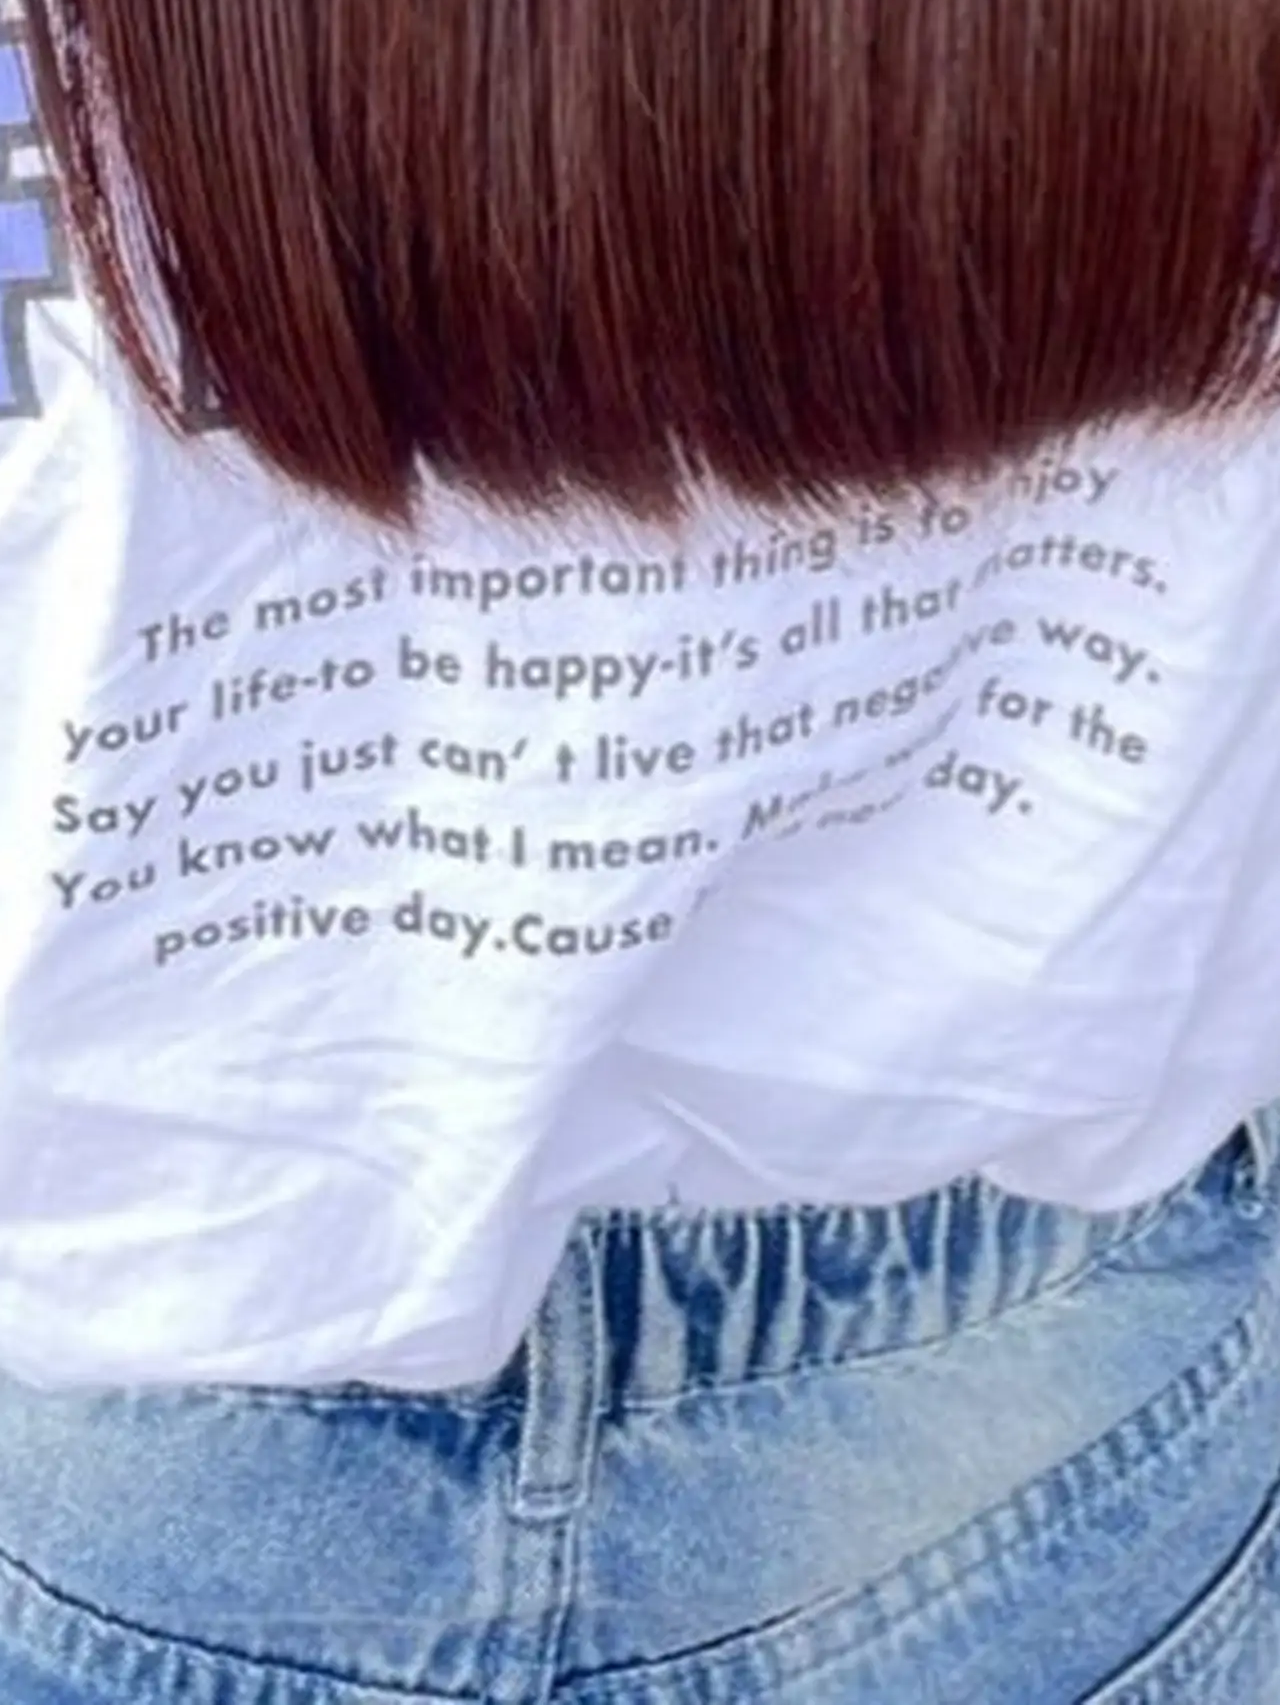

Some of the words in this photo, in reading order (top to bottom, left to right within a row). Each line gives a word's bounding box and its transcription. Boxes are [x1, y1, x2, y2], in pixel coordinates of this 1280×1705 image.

[137, 609, 231, 663] The
[254, 565, 387, 632] most
[409, 552, 686, 613] important
[712, 527, 837, 589] thing
[856, 502, 896, 546] is
[919, 503, 973, 539] to
[1004, 455, 1123, 509] njoy
[50, 793, 158, 840] Say
[177, 758, 279, 819] you
[299, 731, 400, 794] just
[596, 733, 696, 783] live
[715, 701, 815, 763] that
[1036, 616, 1161, 685] way.
[62, 700, 190, 764] your
[211, 657, 377, 721] life-to
[397, 634, 462, 685] be
[485, 627, 761, 701] happy-it's
[778, 594, 841, 656] all
[860, 578, 962, 634] that
[50, 861, 157, 910] You
[178, 825, 337, 879] know
[357, 804, 491, 865] what
[510, 824, 526, 868] I
[548, 827, 719, 872] mean.
[975, 675, 1054, 728] for
[1069, 703, 1148, 764] the
[153, 894, 371, 968] positive
[923, 748, 1032, 817] day.
